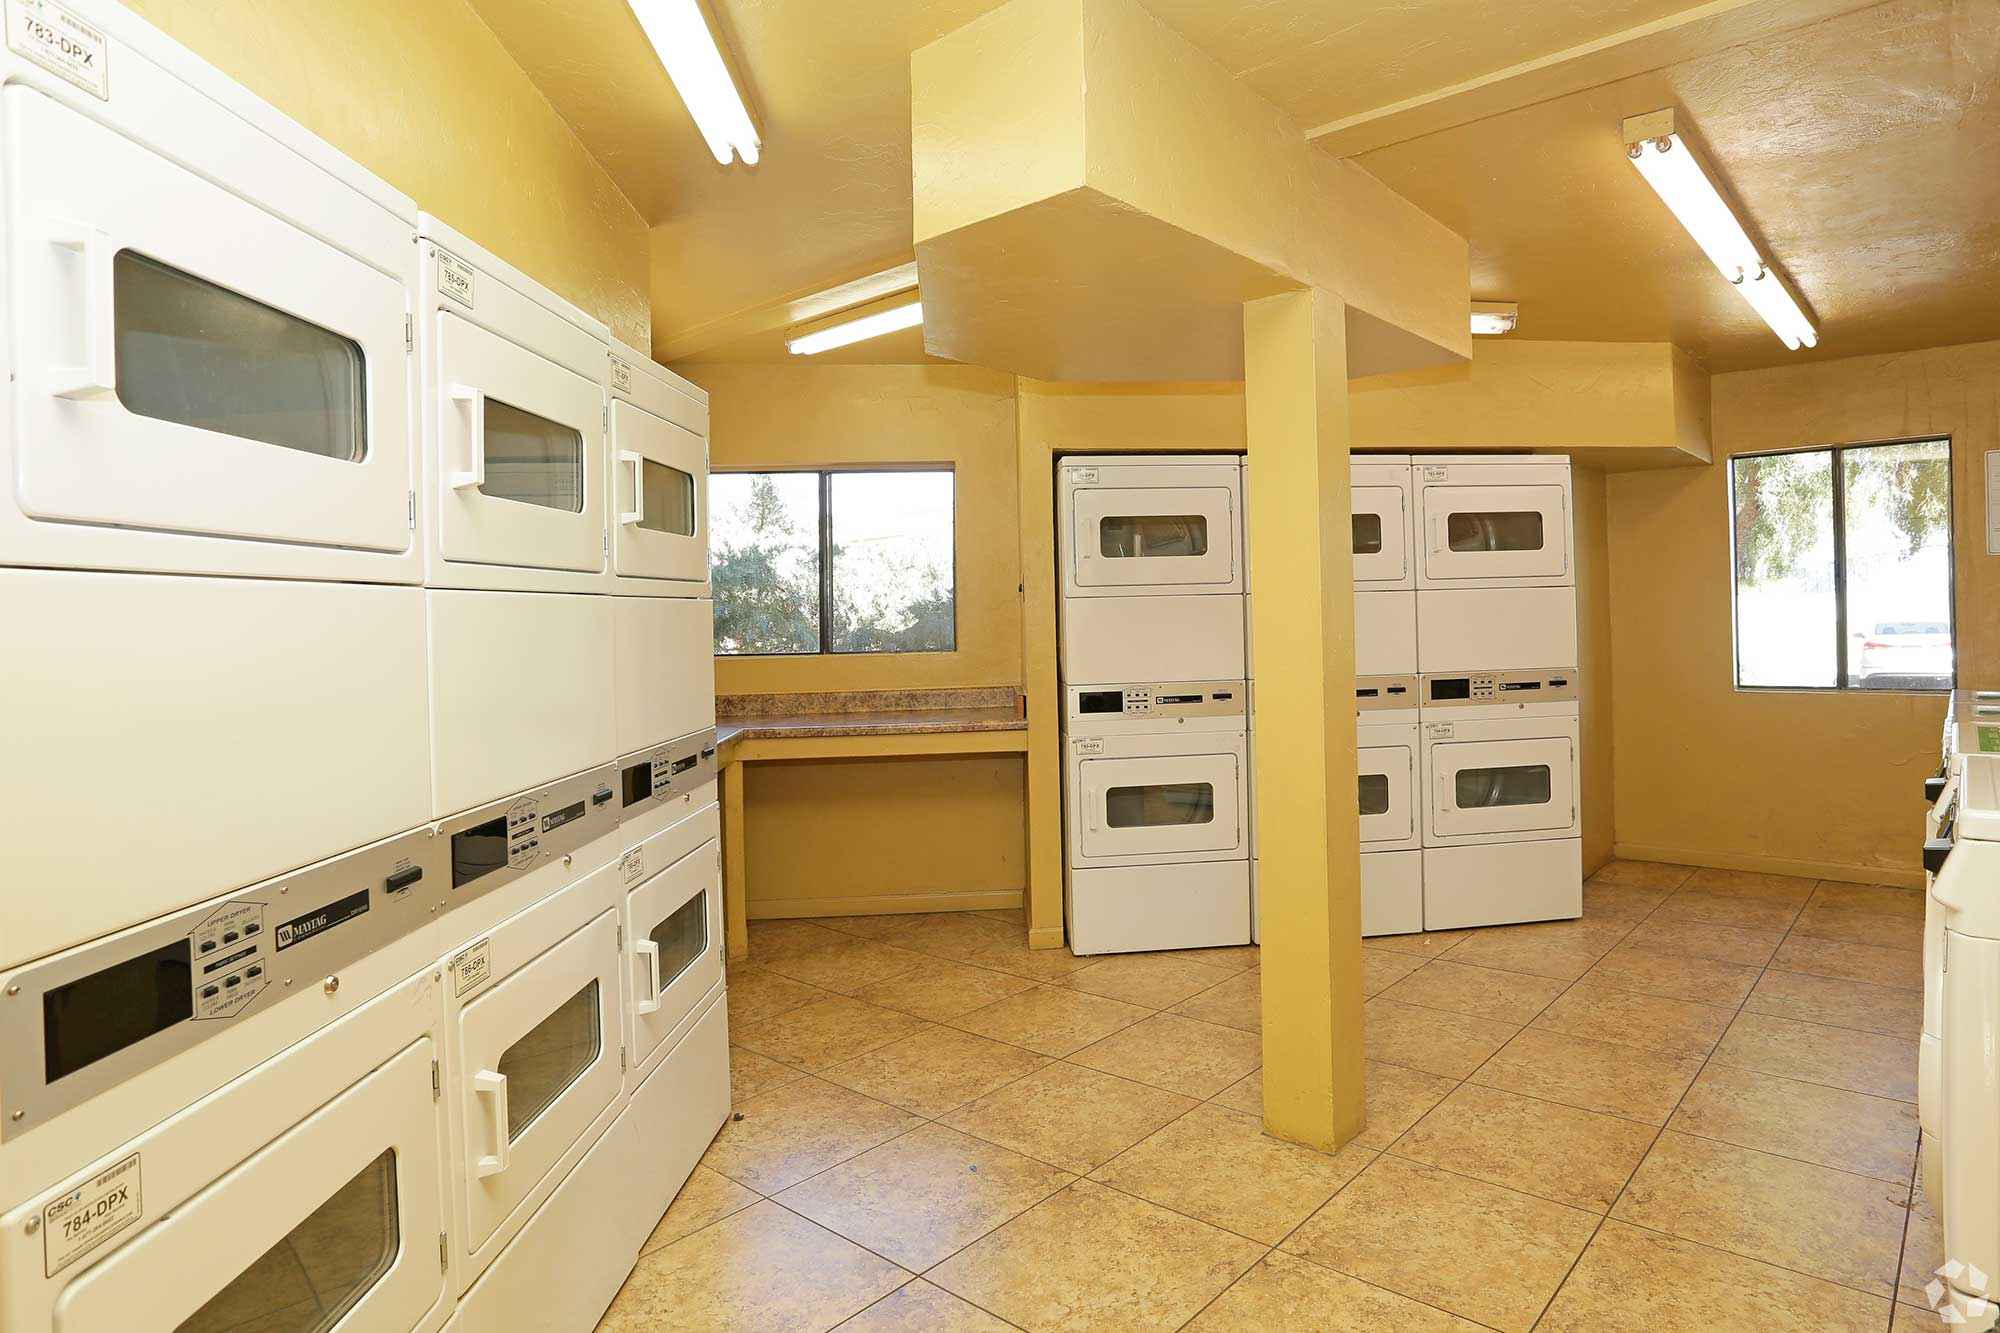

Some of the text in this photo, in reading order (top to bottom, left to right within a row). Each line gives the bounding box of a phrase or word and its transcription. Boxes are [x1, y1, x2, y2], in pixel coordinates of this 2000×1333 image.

[25, 17, 94, 67] 783-DPX
[207, 914, 229, 928] UPPER
[293, 914, 327, 936] MAYTAG
[209, 1000, 233, 1016] LOWER
[234, 989, 256, 1004] DRYER
[48, 1197, 74, 1217] CSC
[63, 1186, 129, 1238] 784-DPX
